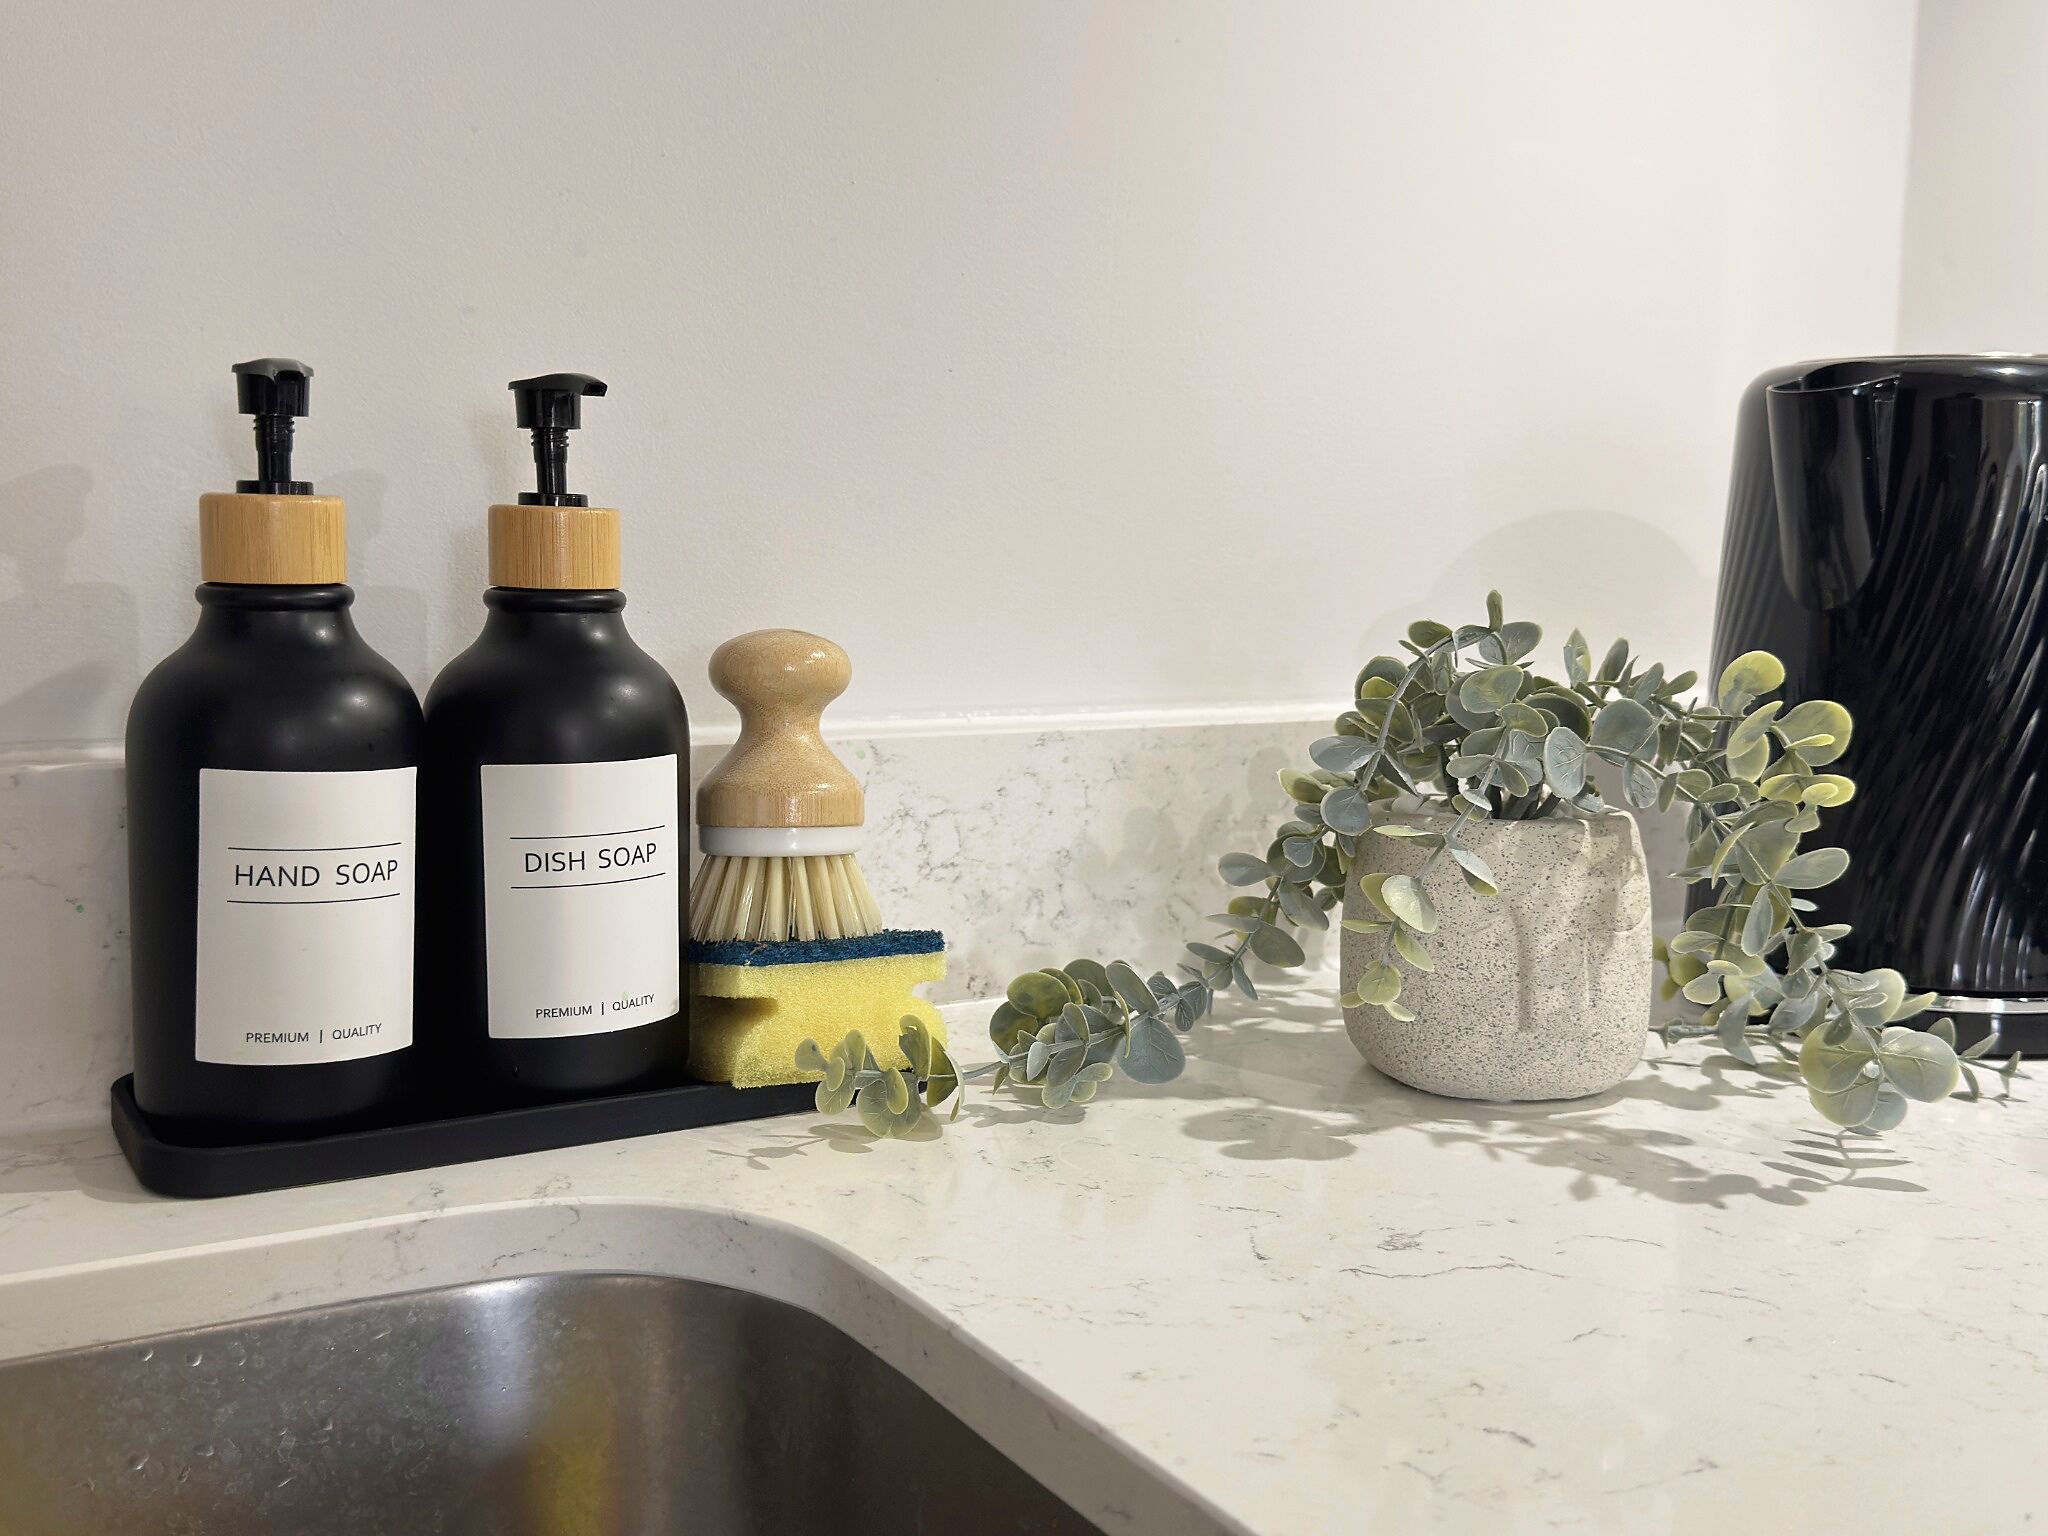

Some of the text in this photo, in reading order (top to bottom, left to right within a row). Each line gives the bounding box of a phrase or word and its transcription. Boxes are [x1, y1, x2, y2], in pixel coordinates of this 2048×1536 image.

[524, 842, 657, 873] DISH SOAP
[234, 859, 399, 887] HAND SOAP
[535, 1004, 593, 1019] PREMIUM
[612, 993, 655, 1012] QUALITY
[245, 1031, 309, 1044] PREMIUM
[331, 1022, 382, 1040] QUALITY
